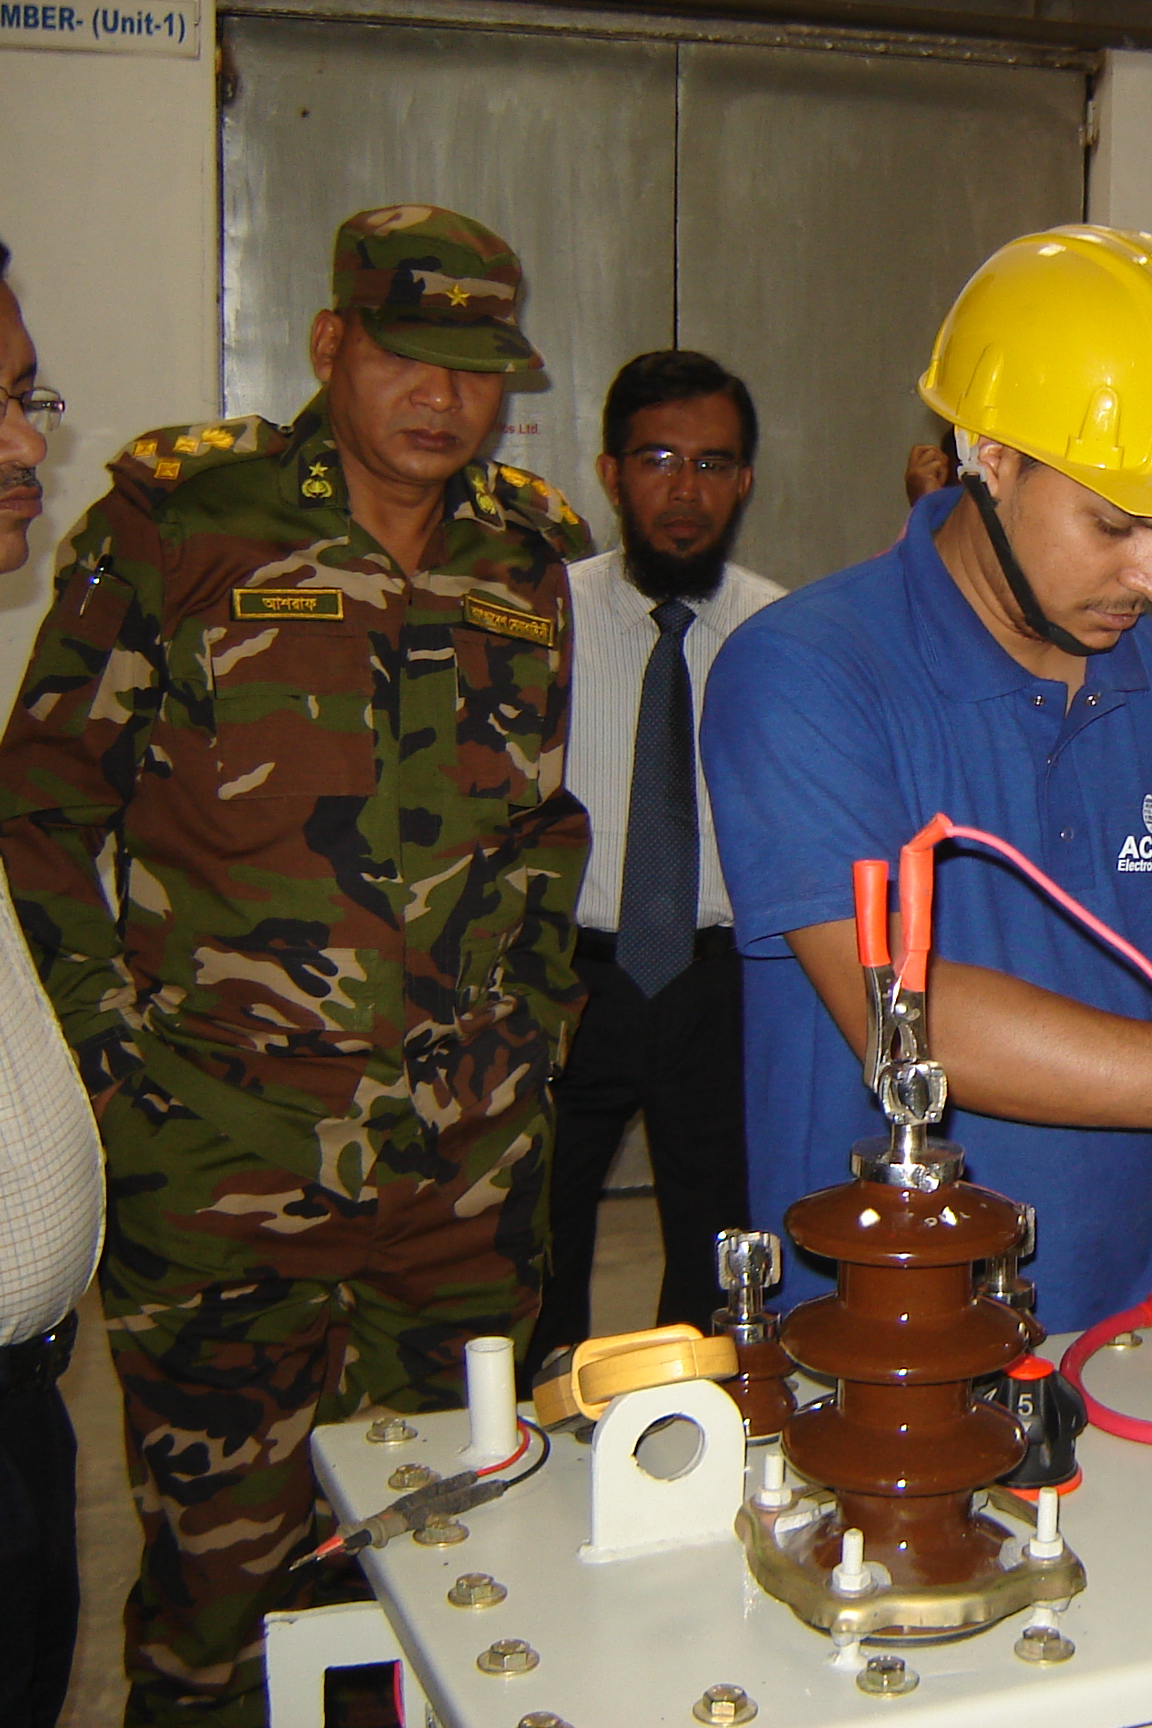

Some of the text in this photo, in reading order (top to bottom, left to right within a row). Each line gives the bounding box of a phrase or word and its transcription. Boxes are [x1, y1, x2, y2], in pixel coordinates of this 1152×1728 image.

[1, 4, 185, 43] MBER- (Unit-1)
[1018, 1393, 1034, 1416] 5
